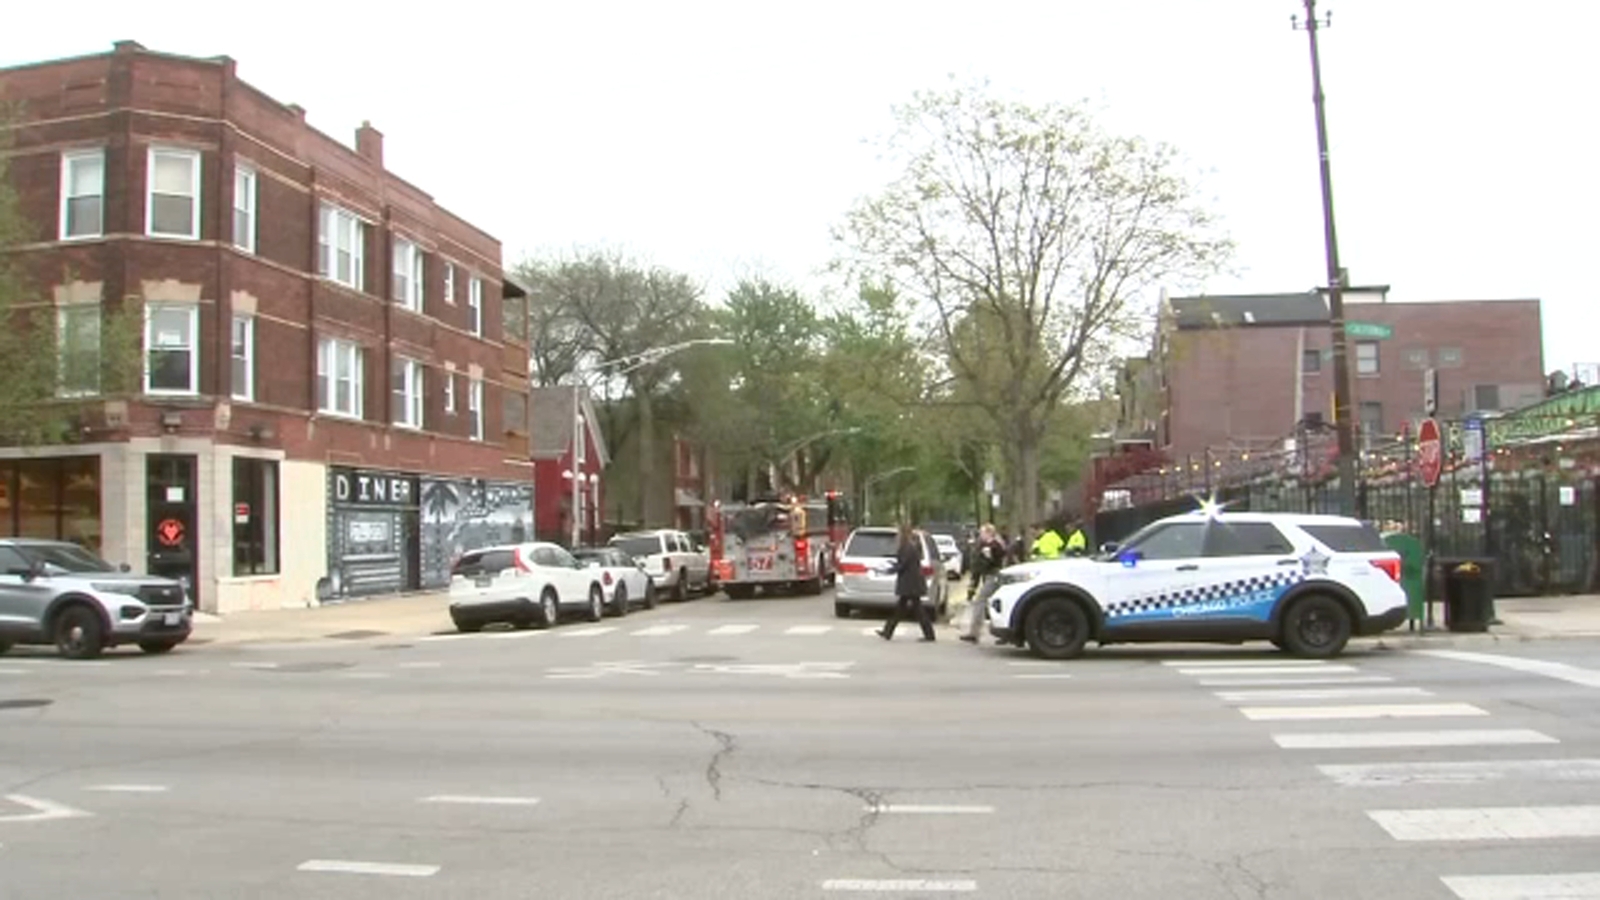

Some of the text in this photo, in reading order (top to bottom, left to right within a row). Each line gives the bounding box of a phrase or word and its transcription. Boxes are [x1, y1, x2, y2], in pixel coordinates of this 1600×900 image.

[336, 475, 411, 502] DINER
[1171, 590, 1276, 618] CHICAGO POLICE
